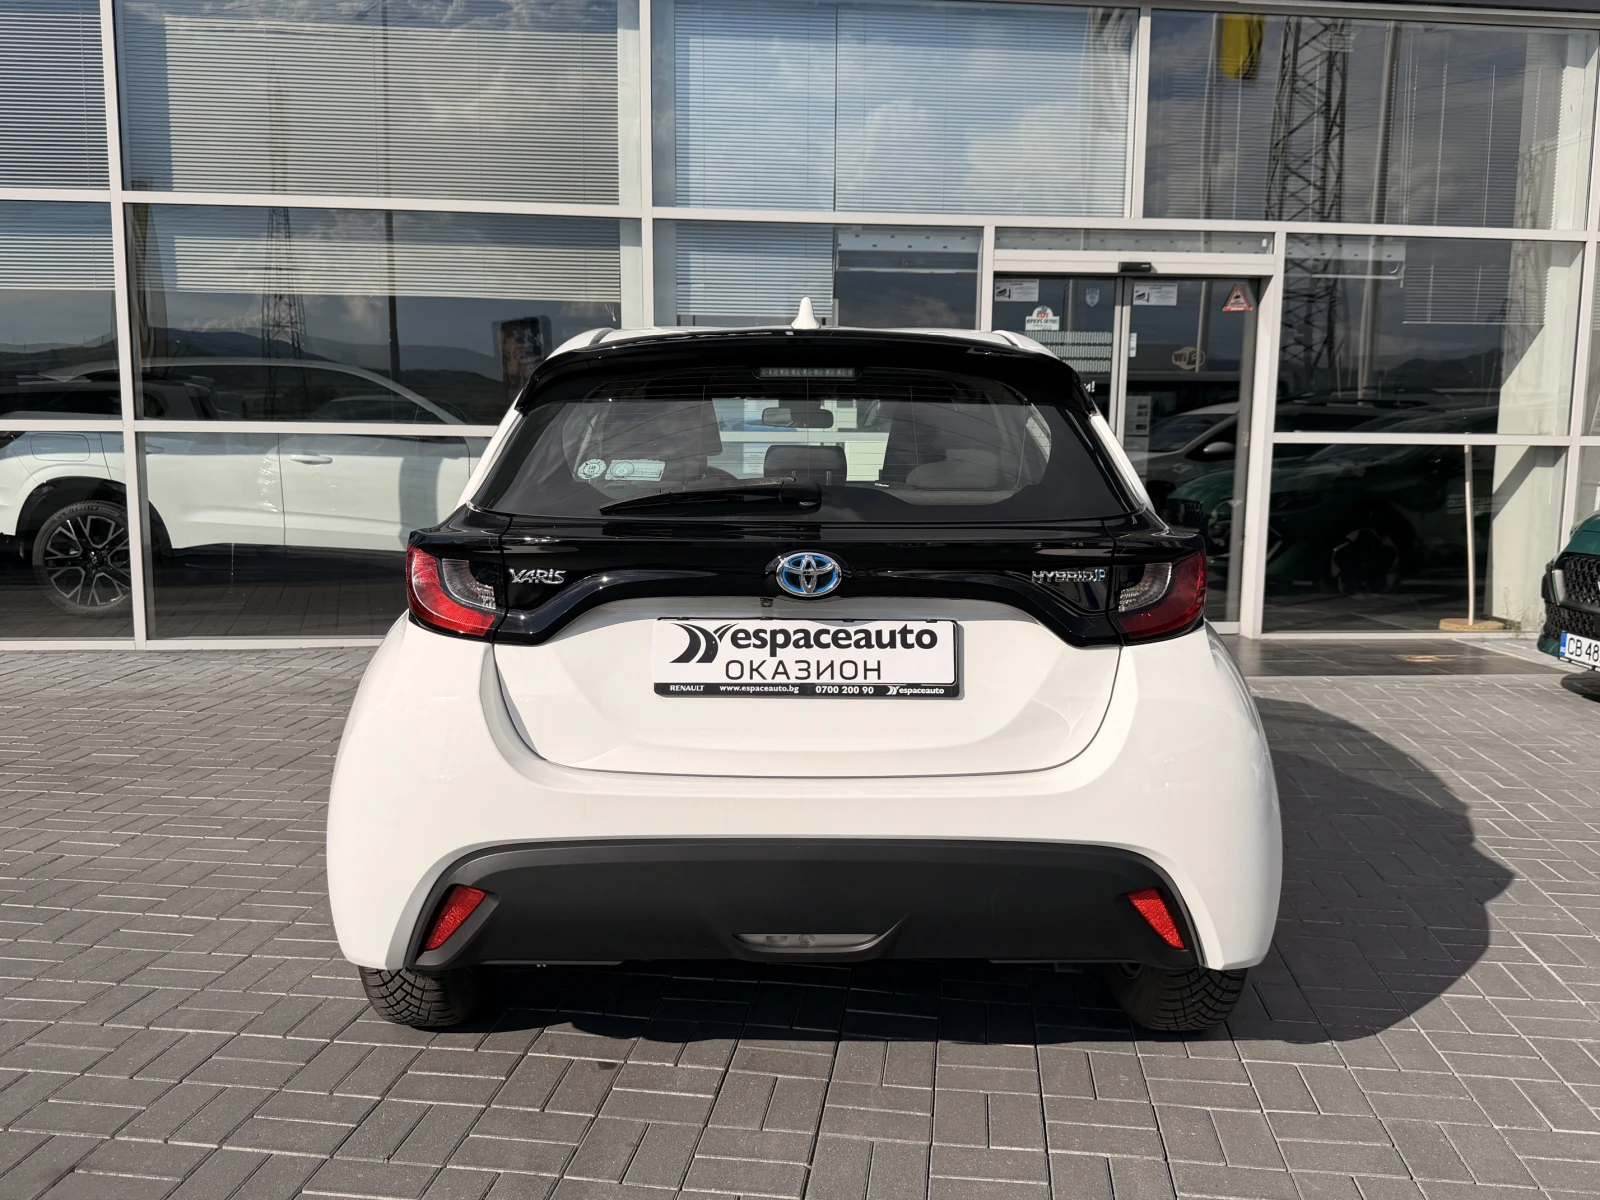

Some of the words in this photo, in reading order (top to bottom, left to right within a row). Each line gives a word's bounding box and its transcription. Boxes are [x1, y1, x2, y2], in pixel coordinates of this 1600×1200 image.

[509, 568, 567, 585] YARIS
[1031, 570, 1095, 583] HYBRID
[730, 623, 938, 658] espaceauto
[1567, 637, 1583, 657] CB
[1584, 642, 1600, 662] 48
[725, 659, 882, 681] ОКАЗИОН
[669, 684, 706, 692] RENAULT
[719, 684, 800, 694] www.espaceauto.bg
[815, 685, 839, 694] 0700
[841, 686, 860, 695] 200
[862, 686, 875, 695] 90
[899, 687, 945, 696] espaceauto
